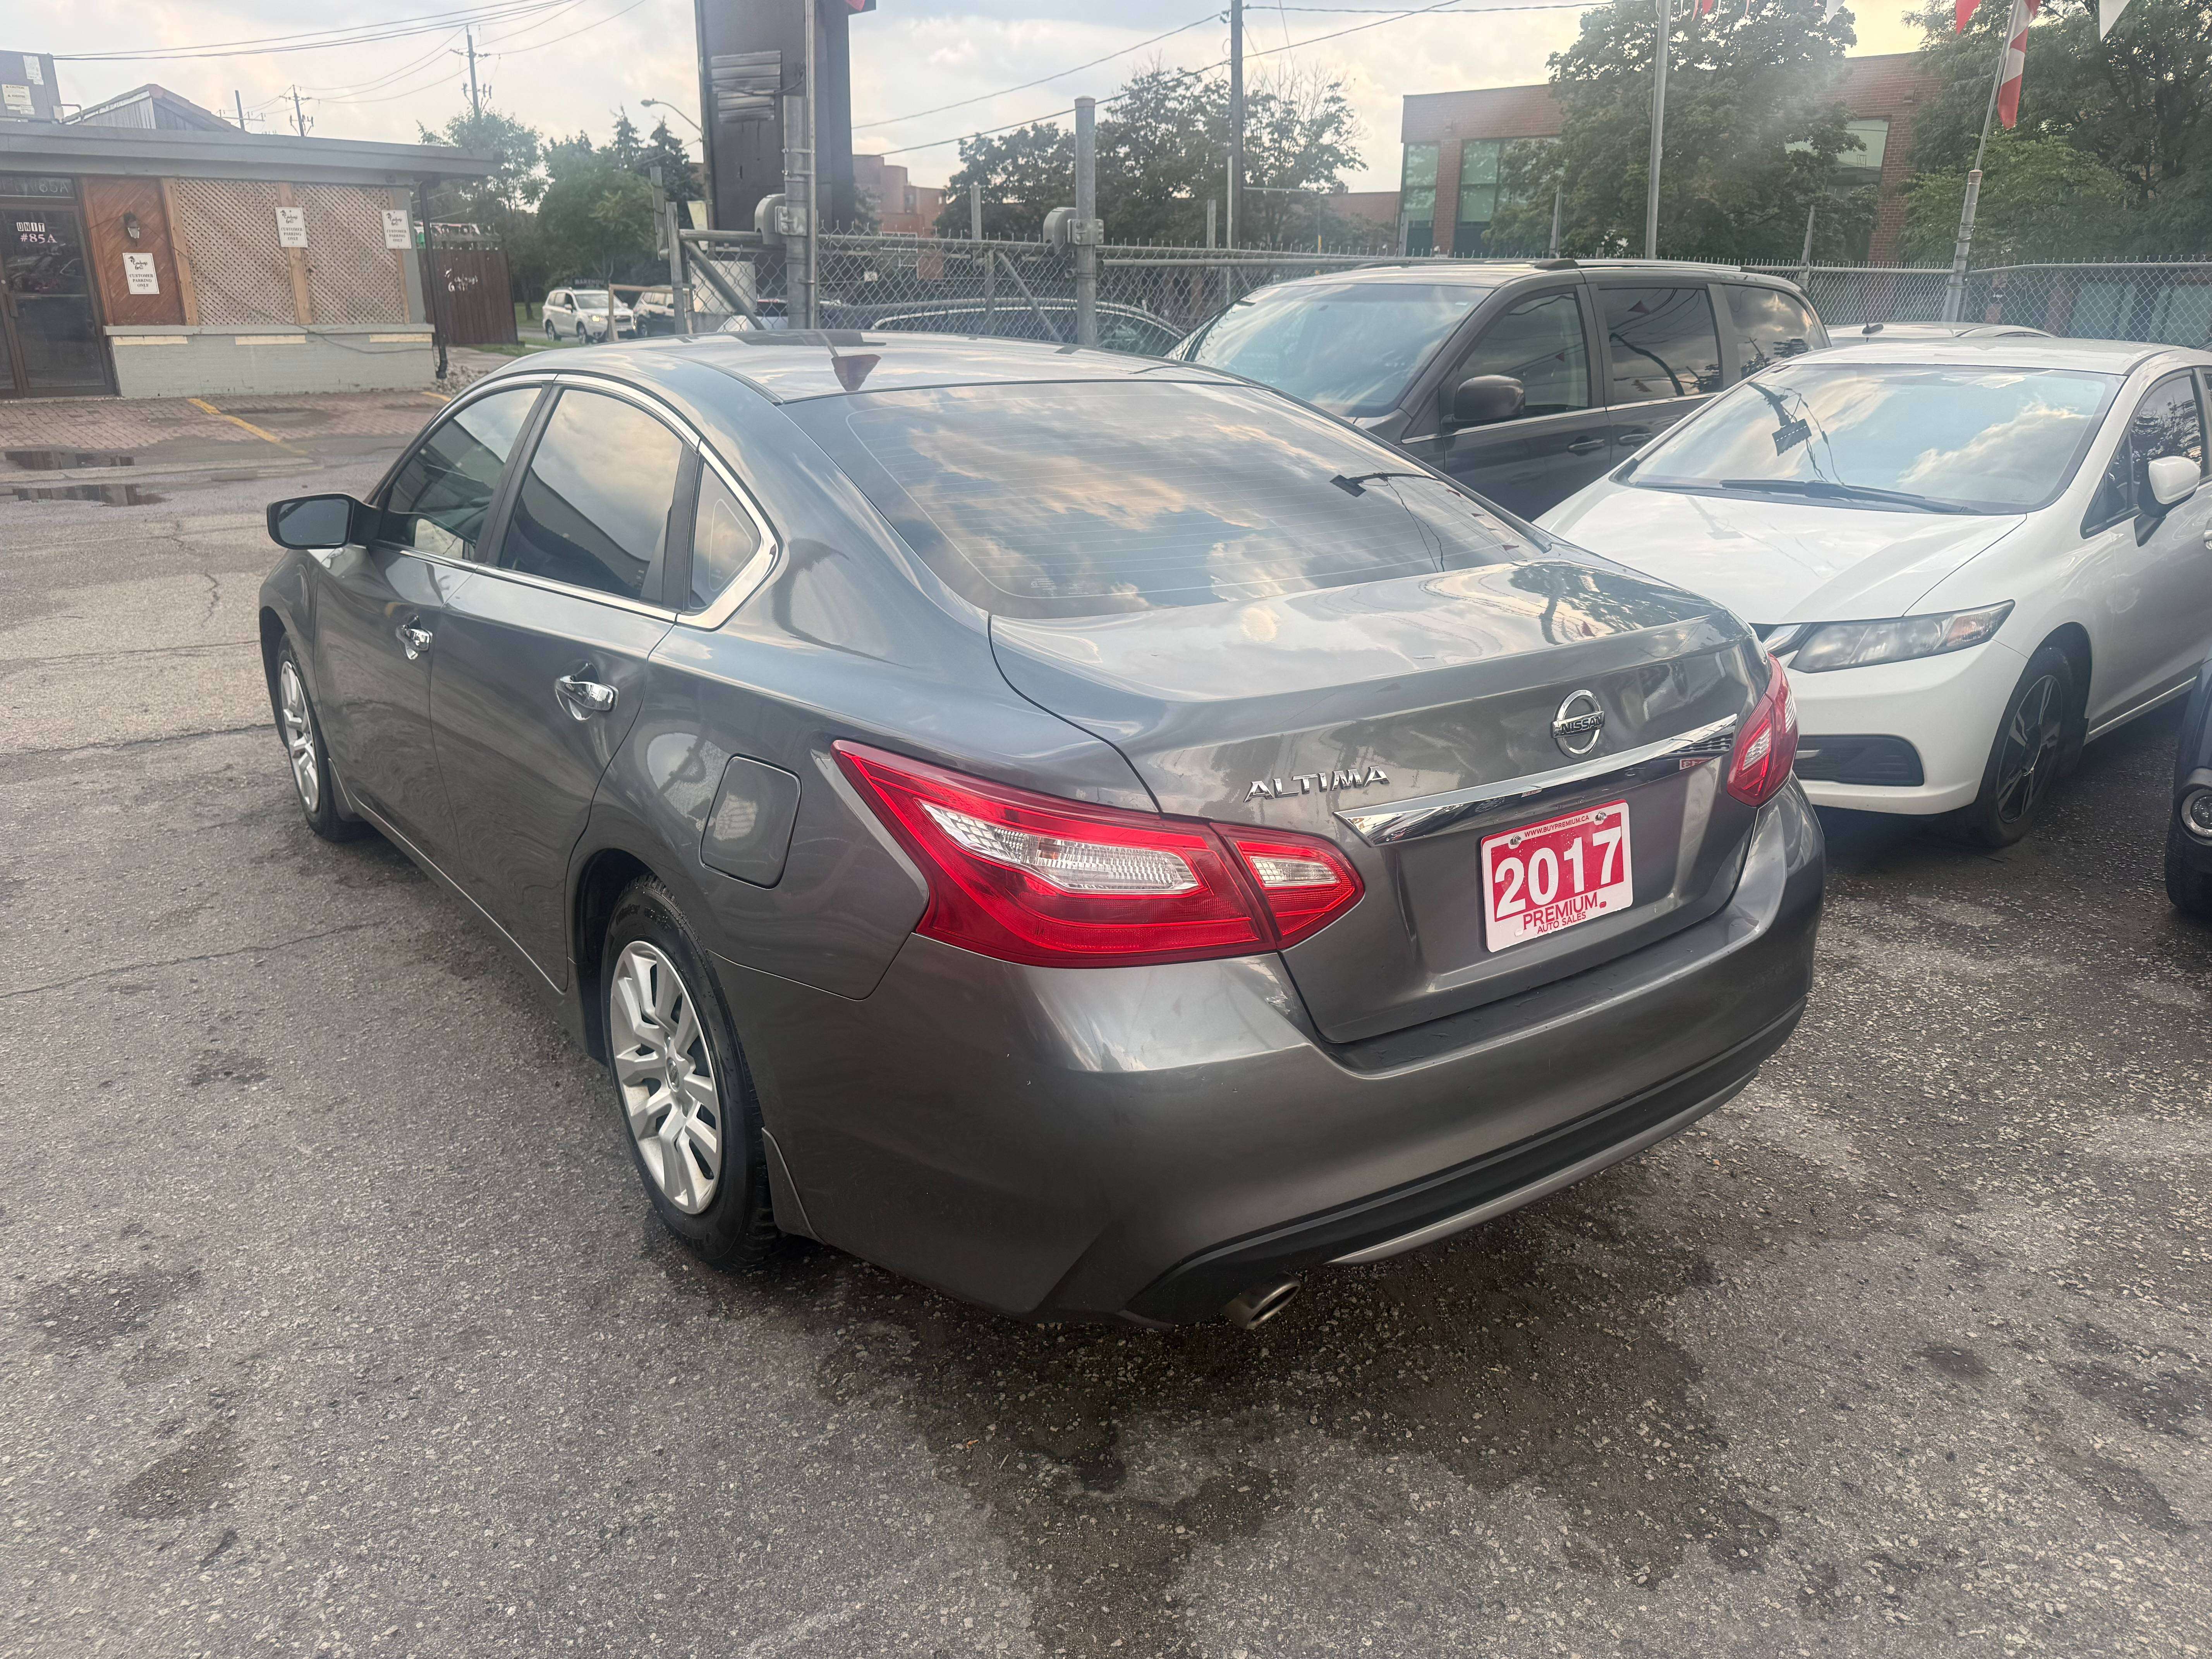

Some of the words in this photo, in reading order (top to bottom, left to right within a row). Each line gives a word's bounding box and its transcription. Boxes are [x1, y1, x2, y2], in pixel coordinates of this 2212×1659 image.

[17, 222, 45, 232] UNIT
[21, 233, 57, 244] #85A
[1561, 716, 1602, 735] NISSAN
[1243, 766, 1390, 802] ALTIMA
[1524, 815, 1590, 837] WWW.BUYPREMIUM.CA
[1495, 826, 1621, 919] 2017
[1523, 892, 1598, 930] PREMIUM
[1537, 921, 1559, 934] AUTO
[1562, 912, 1587, 926] SALES
